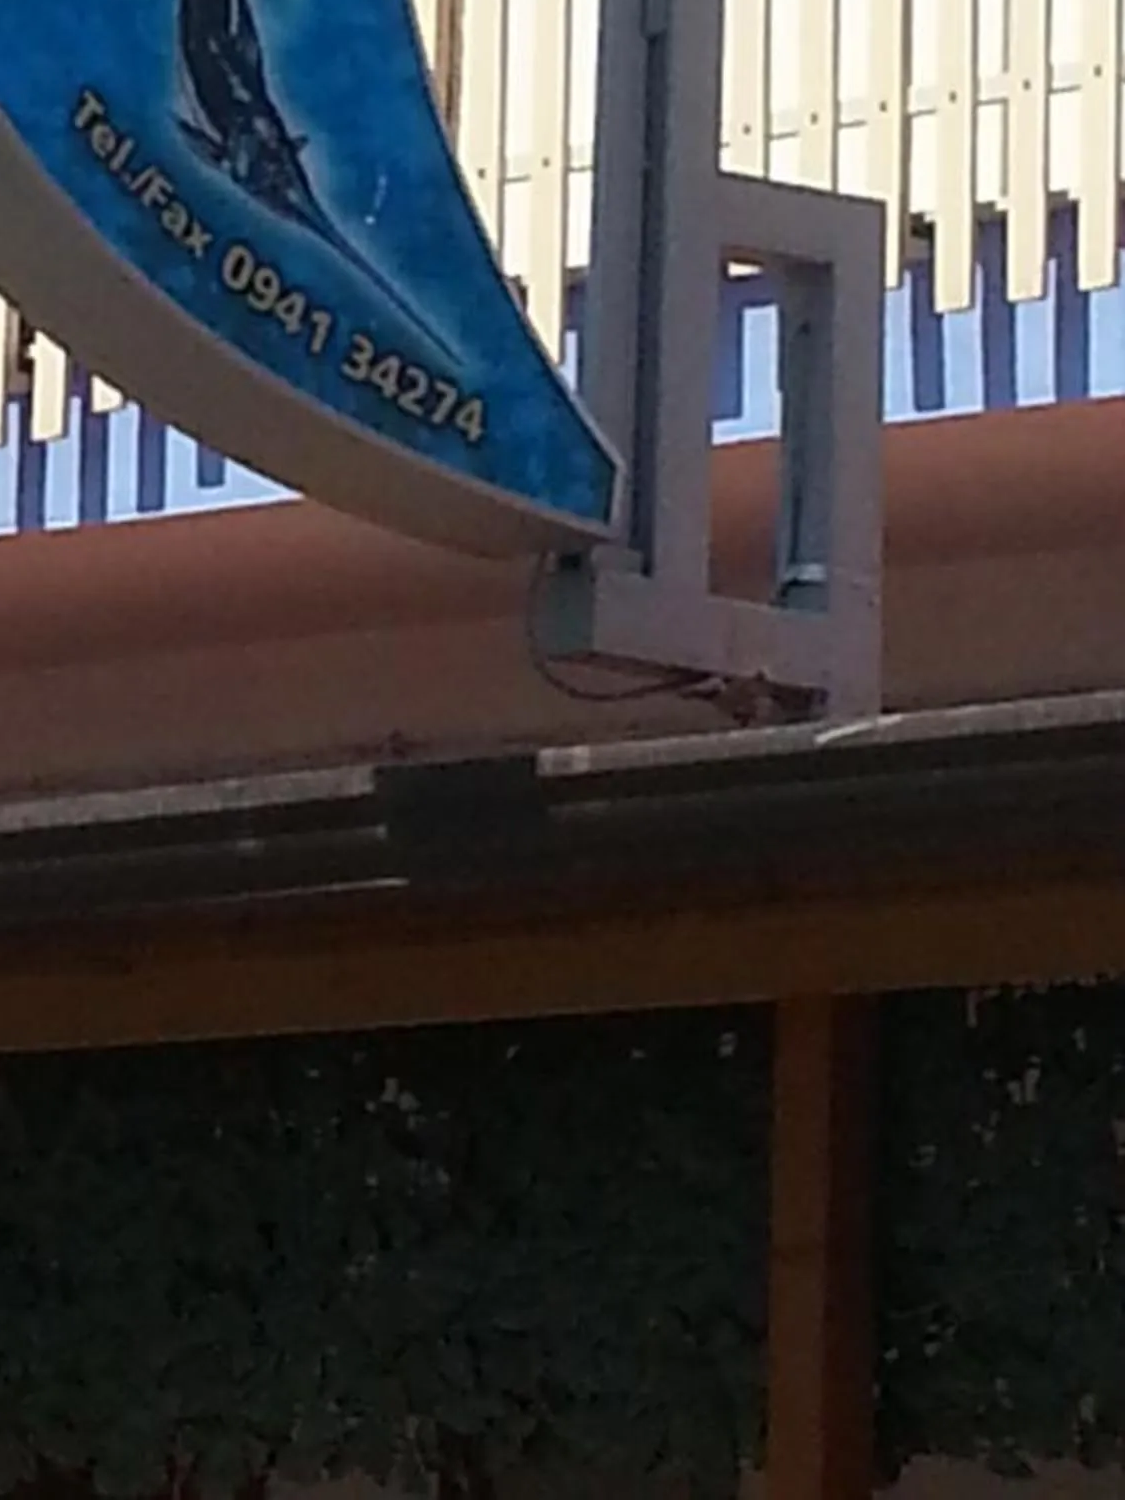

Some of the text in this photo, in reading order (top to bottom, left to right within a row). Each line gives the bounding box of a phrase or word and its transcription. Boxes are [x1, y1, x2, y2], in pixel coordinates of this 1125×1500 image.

[75, 91, 484, 441] Tel./Fax 0941 34274
